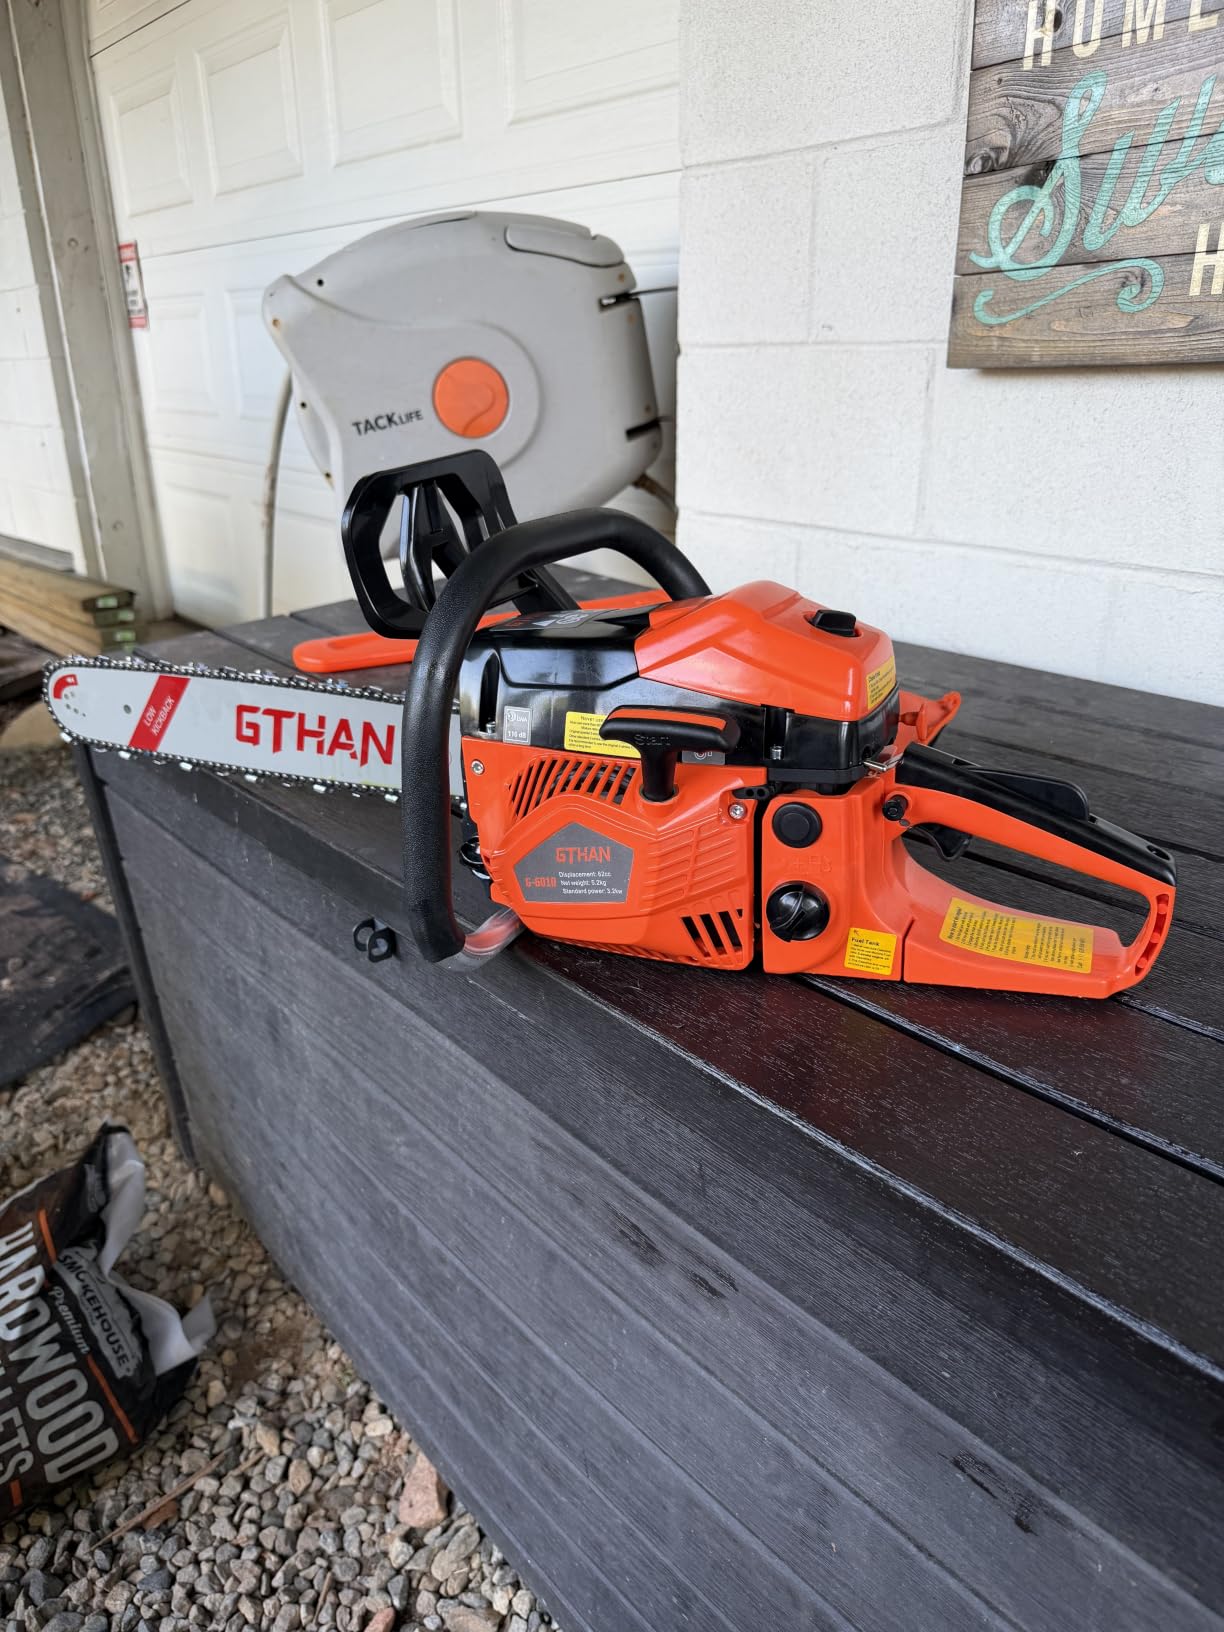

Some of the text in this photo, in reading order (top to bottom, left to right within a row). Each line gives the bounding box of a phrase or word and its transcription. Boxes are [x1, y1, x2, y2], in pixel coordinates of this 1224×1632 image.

[352, 410, 424, 436] TACKLIFE
[143, 705, 157, 727] LOW
[151, 695, 175, 737] KICKBACK
[236, 704, 396, 767] GTHAN
[555, 846, 611, 864] GTHAN
[48, 1285, 91, 1355] Premium
